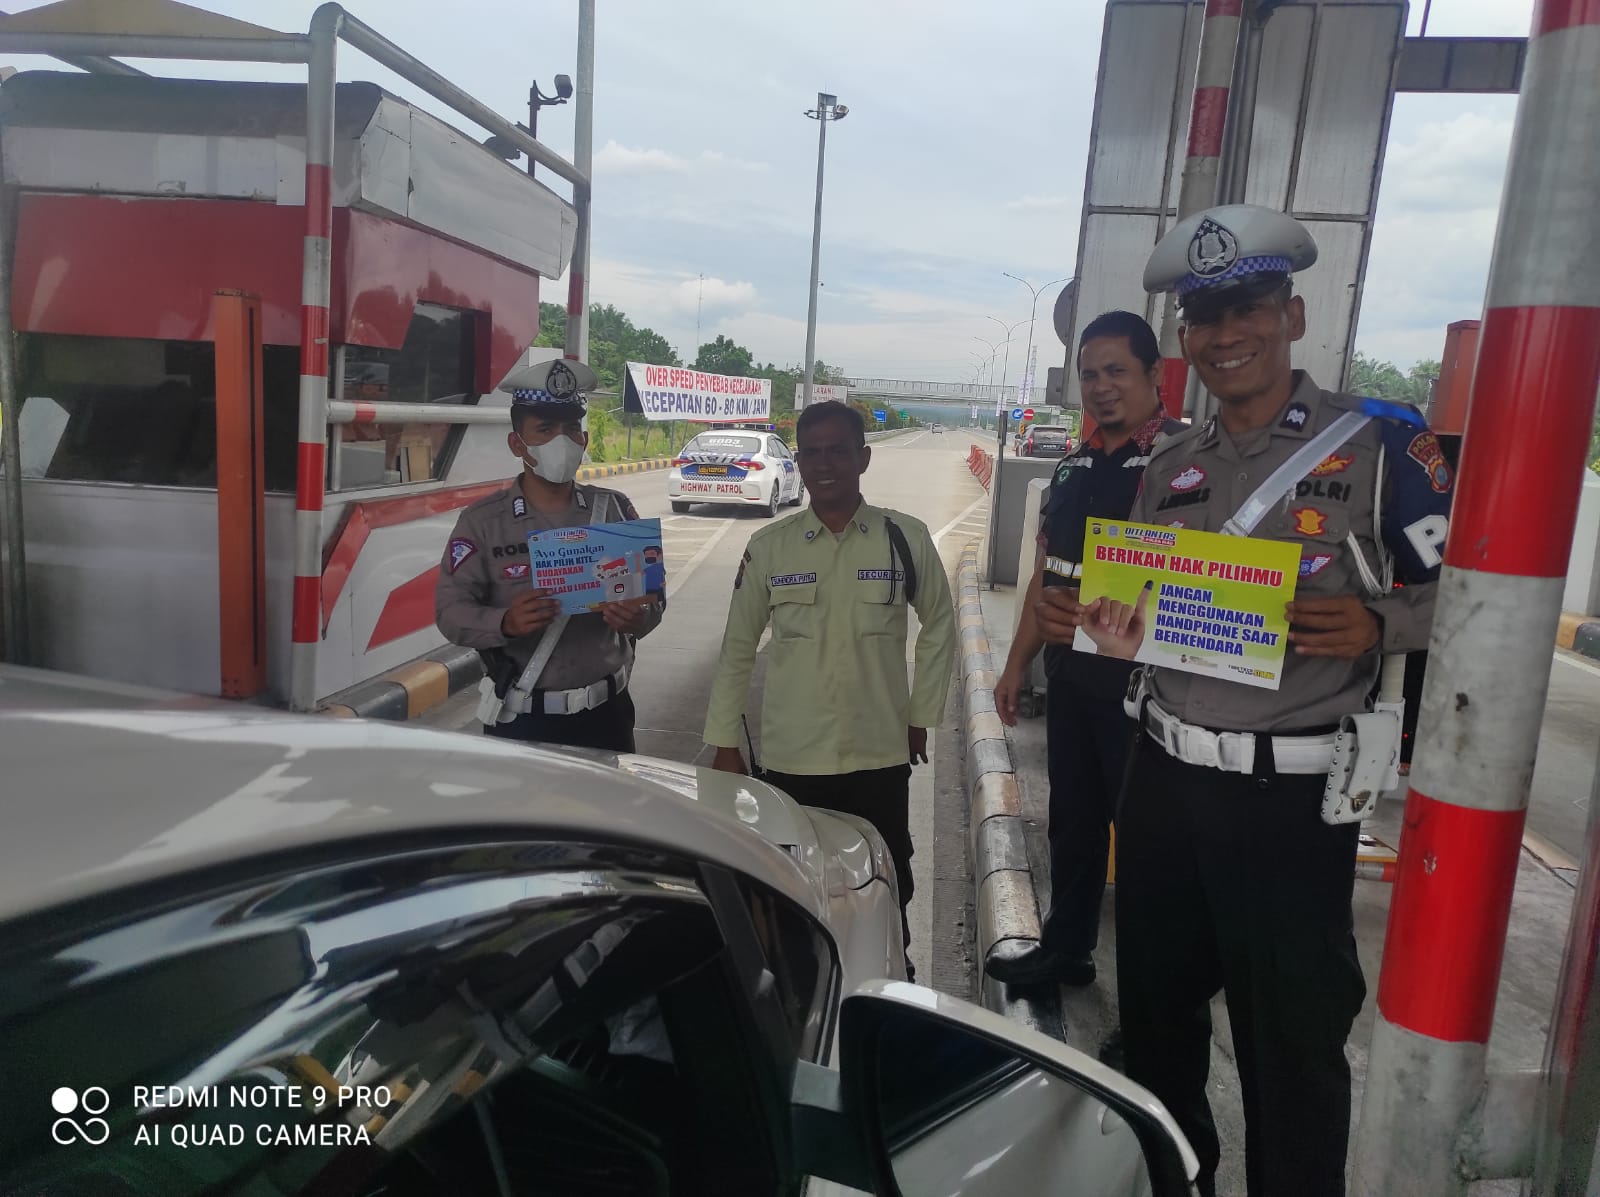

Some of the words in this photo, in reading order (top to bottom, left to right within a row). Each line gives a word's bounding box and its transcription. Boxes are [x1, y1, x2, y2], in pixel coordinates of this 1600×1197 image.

[646, 366, 668, 387] OVER
[670, 367, 693, 390] SPEED
[696, 372, 729, 394] PENYEBAB
[705, 397, 717, 415] 60
[724, 398, 735, 415] 80
[736, 398, 767, 417] KM/JAM
[680, 483, 712, 493] HIGHWAY
[716, 484, 744, 494] PATROL
[1296, 480, 1352, 502] OLRI
[534, 549, 555, 559] Ayo
[558, 544, 605, 558] Gunakan
[536, 559, 552, 568] HAK
[554, 558, 574, 567] PILIH
[537, 565, 584, 578] BUDAYAKAN
[1095, 545, 1166, 570] BERIKAN
[1169, 555, 1204, 576] HAK
[1207, 560, 1284, 587] PILIHMU
[537, 577, 566, 587] TERTIB
[860, 571, 902, 580] SECURIY
[574, 580, 601, 592] LINTAS
[1160, 583, 1212, 604] JANGAN
[1158, 599, 1264, 628] MENGGUNAKAN
[1156, 613, 1239, 640] HANDPHONE
[1242, 630, 1279, 647] SAAT
[1154, 629, 1243, 657] BERKENDARA
